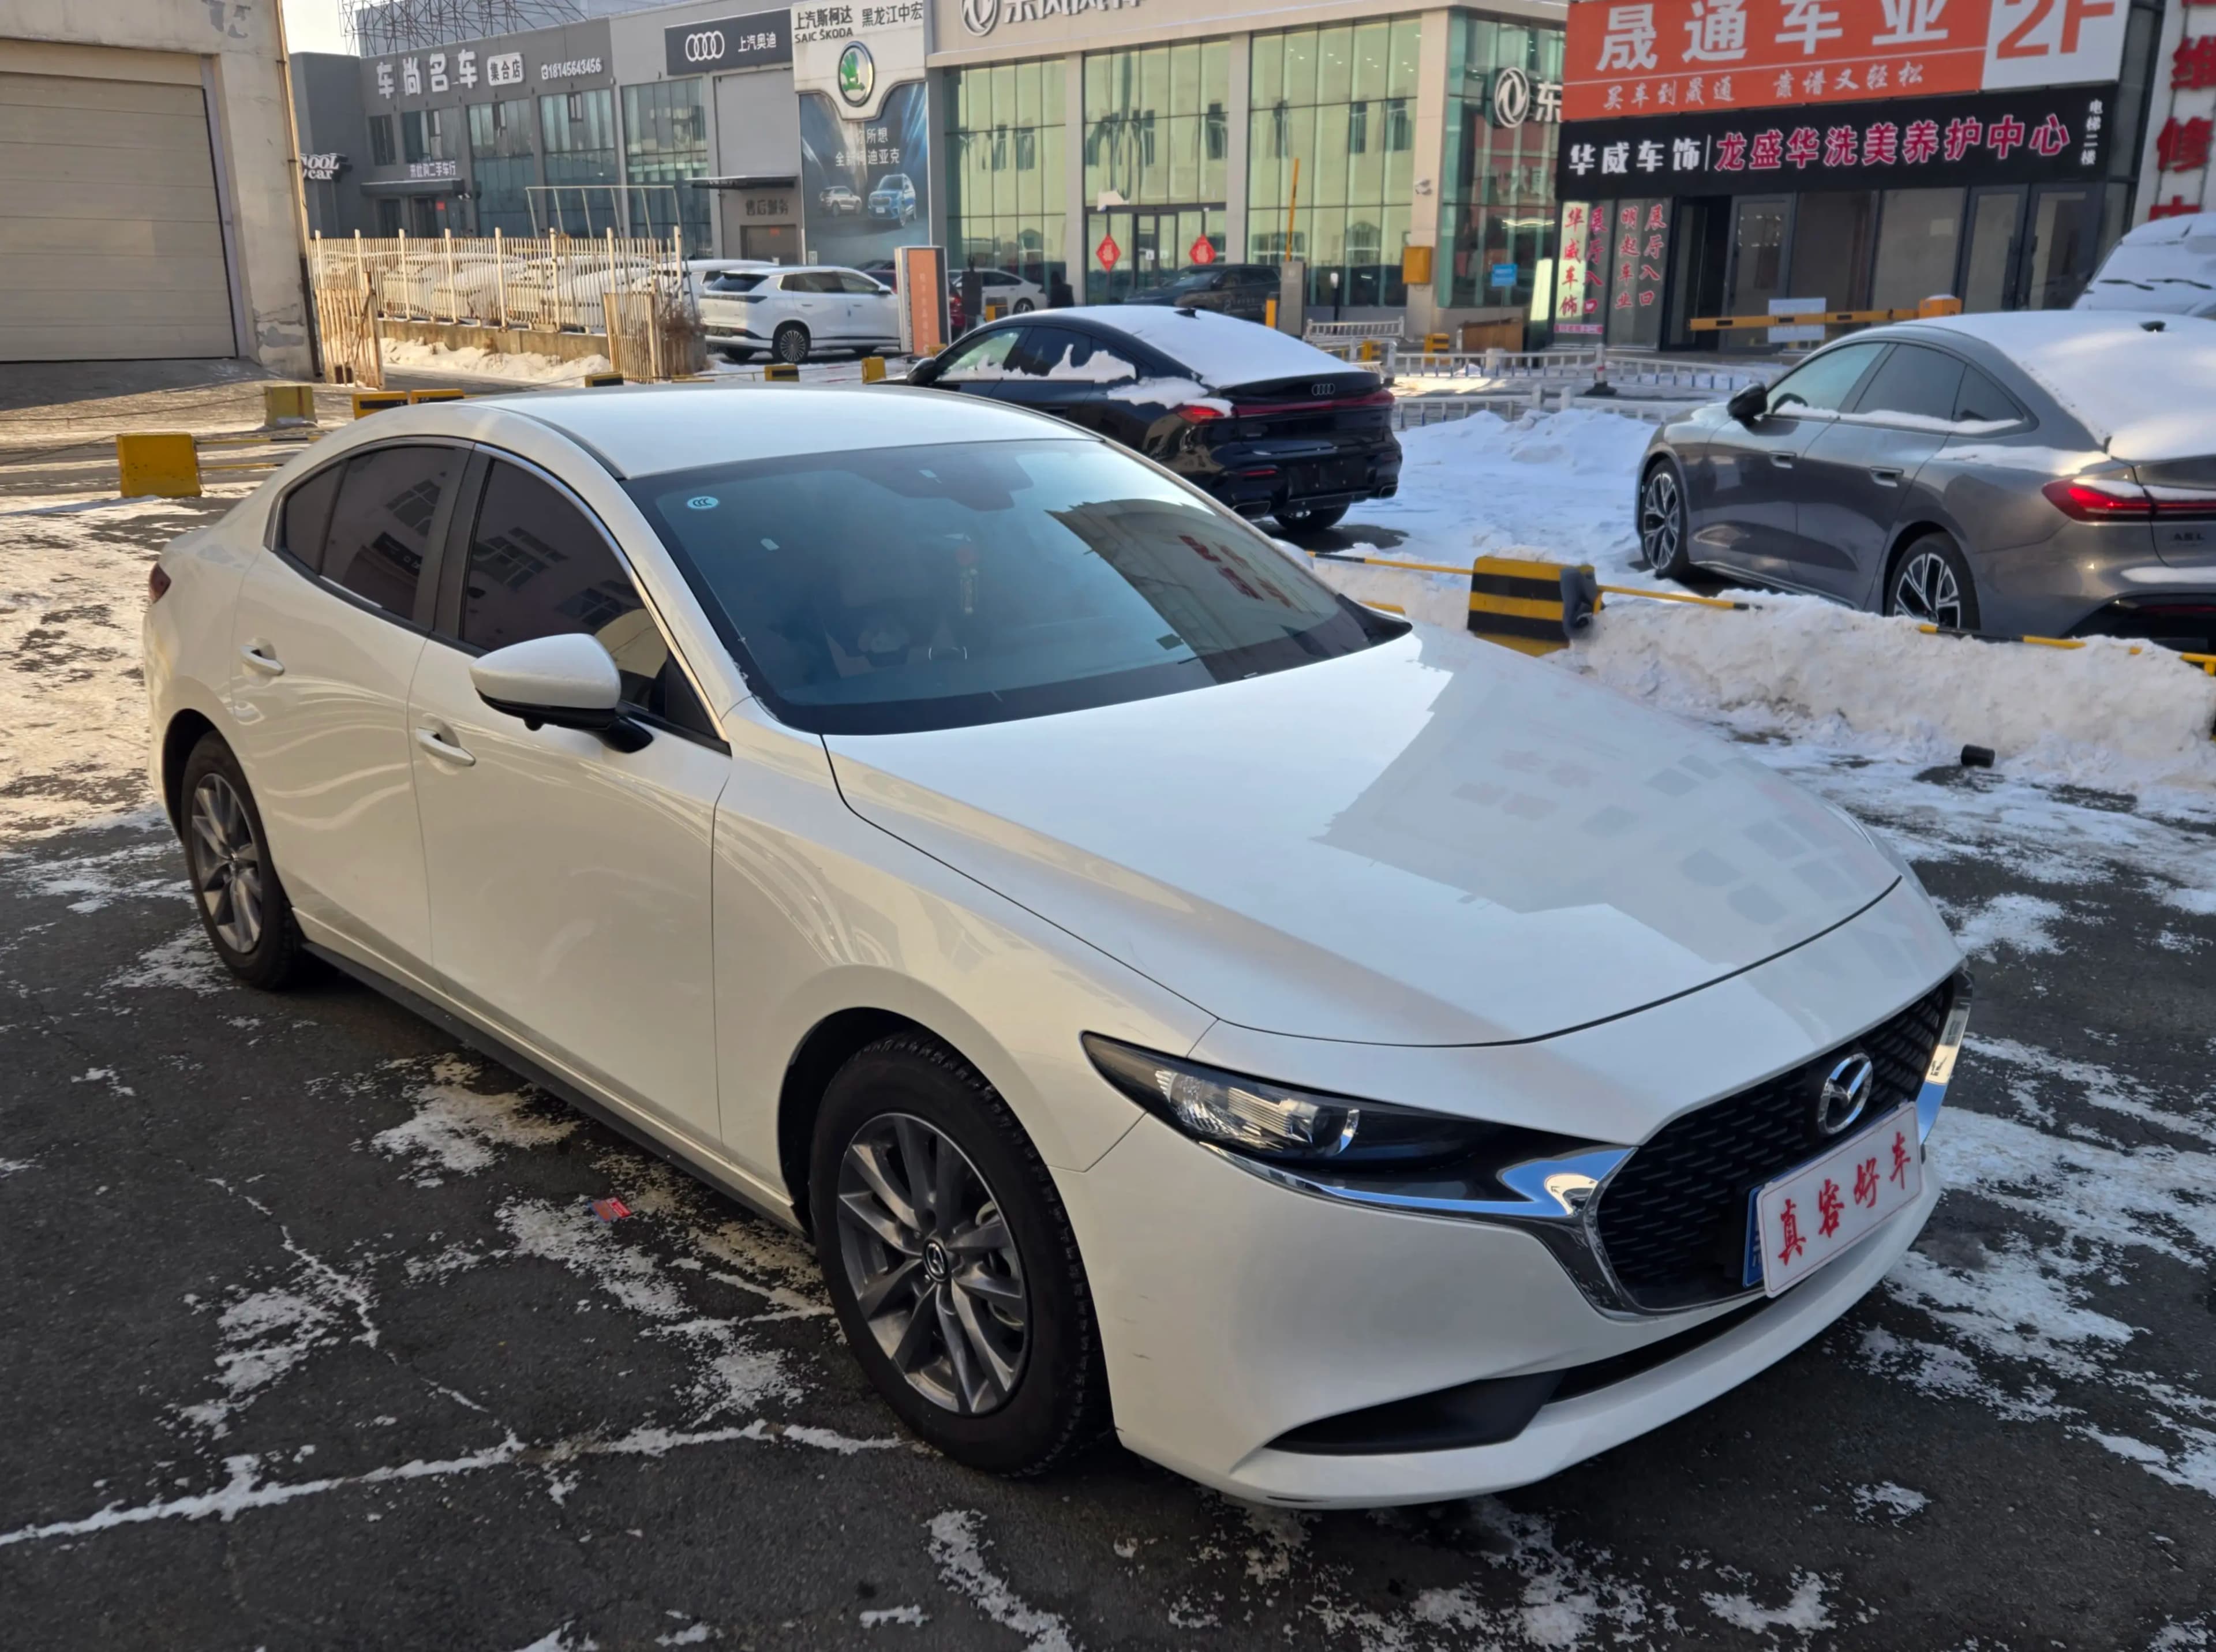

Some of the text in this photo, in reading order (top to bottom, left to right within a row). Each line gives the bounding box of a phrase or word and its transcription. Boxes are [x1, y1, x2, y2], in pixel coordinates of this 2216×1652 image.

[738, 31, 777, 53] 上汽奥迪
[794, 1, 924, 31] 上汽斯柯达 黑龙江中宏
[795, 28, 854, 44] SAIC ŠKODA
[1596, 0, 1949, 71] 晟通车业
[376, 48, 479, 99] 车尚名车
[489, 58, 521, 81] 集合店
[1603, 76, 1735, 111] 买车到晟通
[1568, 113, 2071, 175] 华威车饰 龙盛华洗美养护中心
[2080, 98, 2103, 166] 电梯二楼
[1559, 207, 1585, 319] 华威车饰
[1583, 205, 1608, 313] 展厅入口
[1638, 203, 1667, 306] 展厅入口
